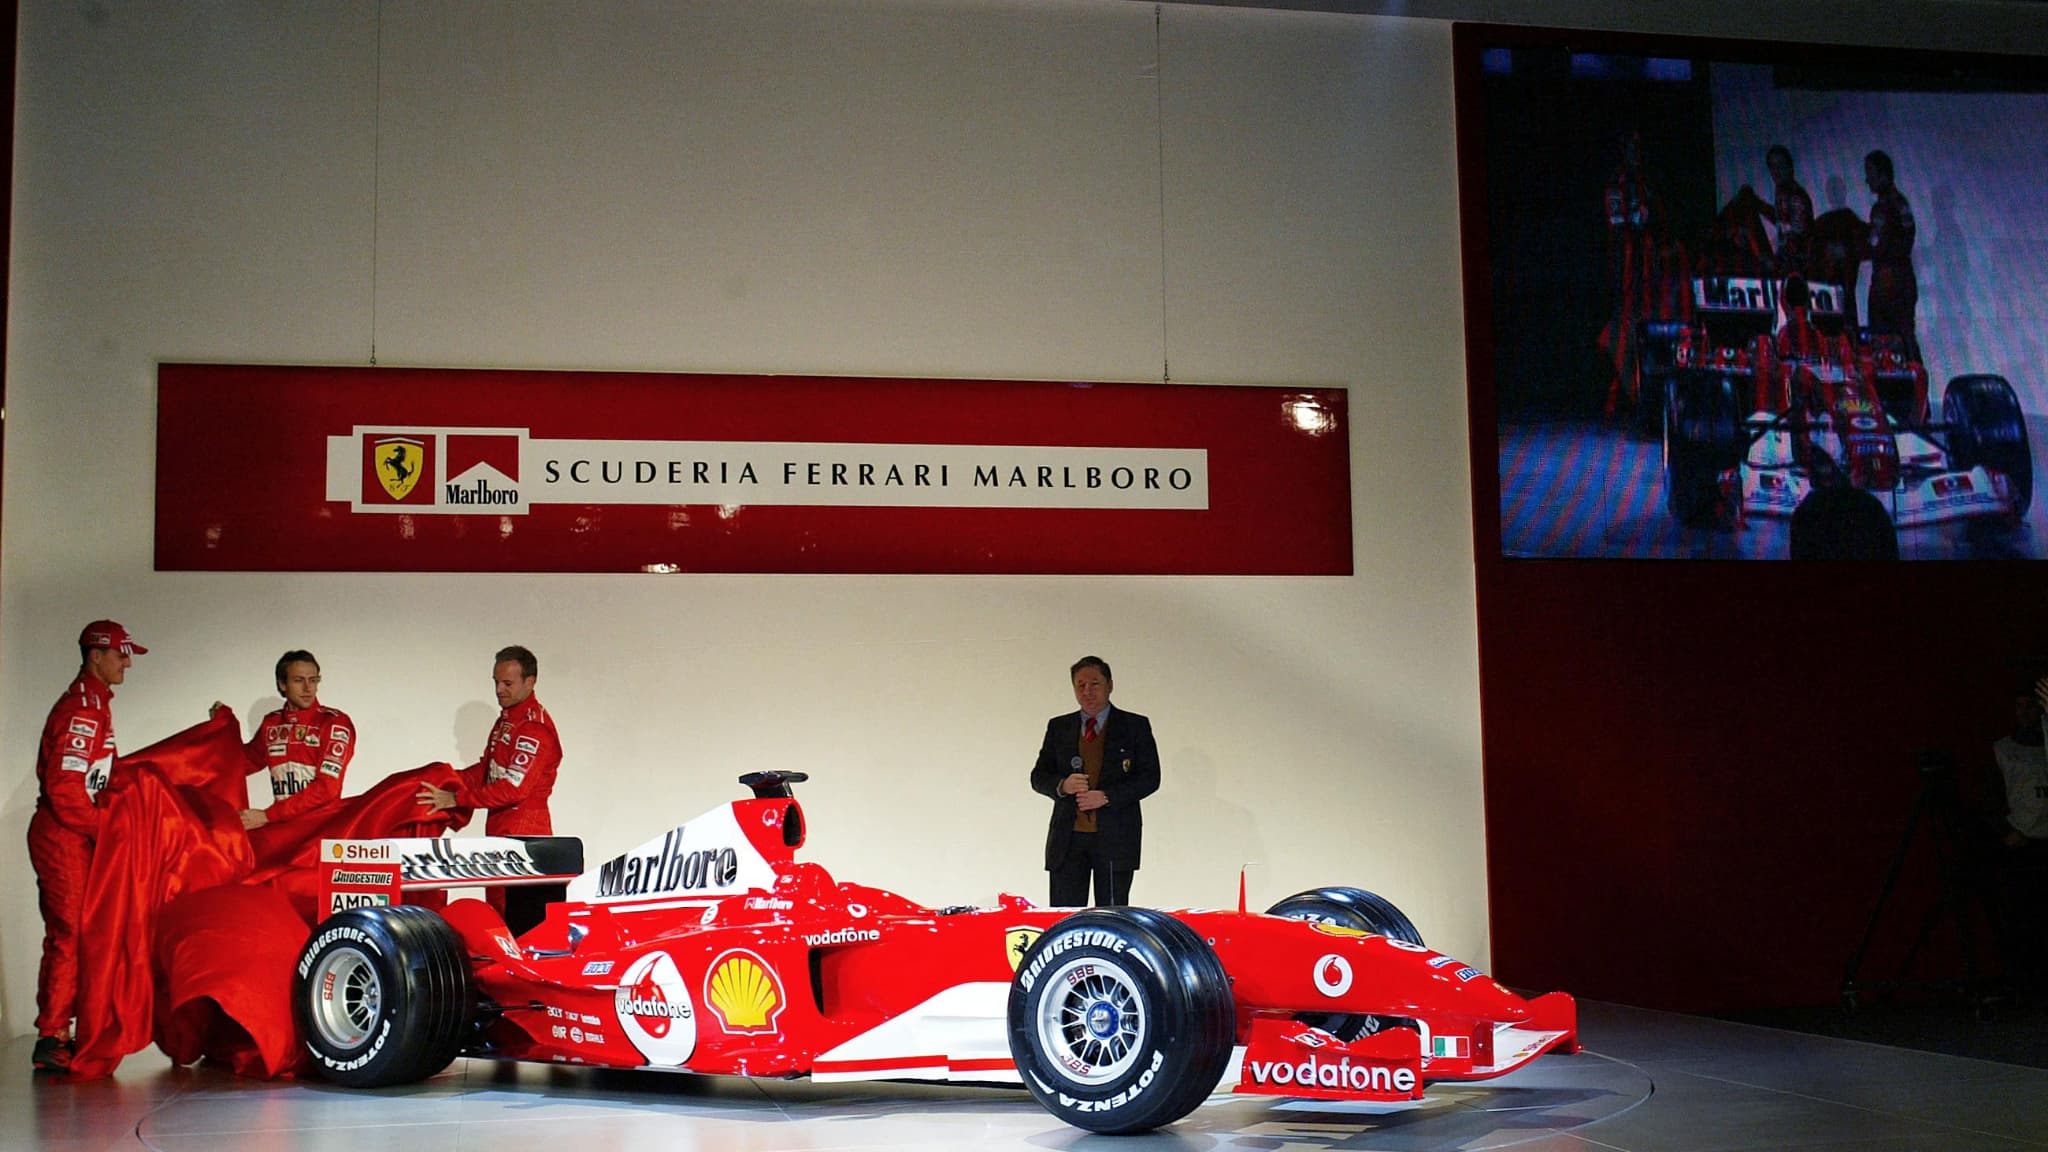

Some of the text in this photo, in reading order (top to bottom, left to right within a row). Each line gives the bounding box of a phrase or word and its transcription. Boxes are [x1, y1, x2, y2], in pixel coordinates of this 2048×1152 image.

[1701, 278, 1835, 311] Marlro
[545, 460, 1193, 491] SCUDERIA FERRARI MARLBORO
[446, 480, 518, 504] Marlboro
[346, 845, 390, 859] Shell
[595, 826, 738, 898] Marlboro
[333, 871, 392, 885] BRIDGESTONE
[332, 895, 373, 912] AMD
[806, 928, 880, 946] vodafone
[298, 927, 366, 980] BRIDGESTONE
[1020, 931, 1128, 993] BRIDGESTONE
[616, 995, 692, 1018] vodafone
[324, 1019, 391, 1071] POTENZA
[1058, 1050, 1164, 1113] POTENZA
[1252, 1055, 1416, 1092] vodafone
